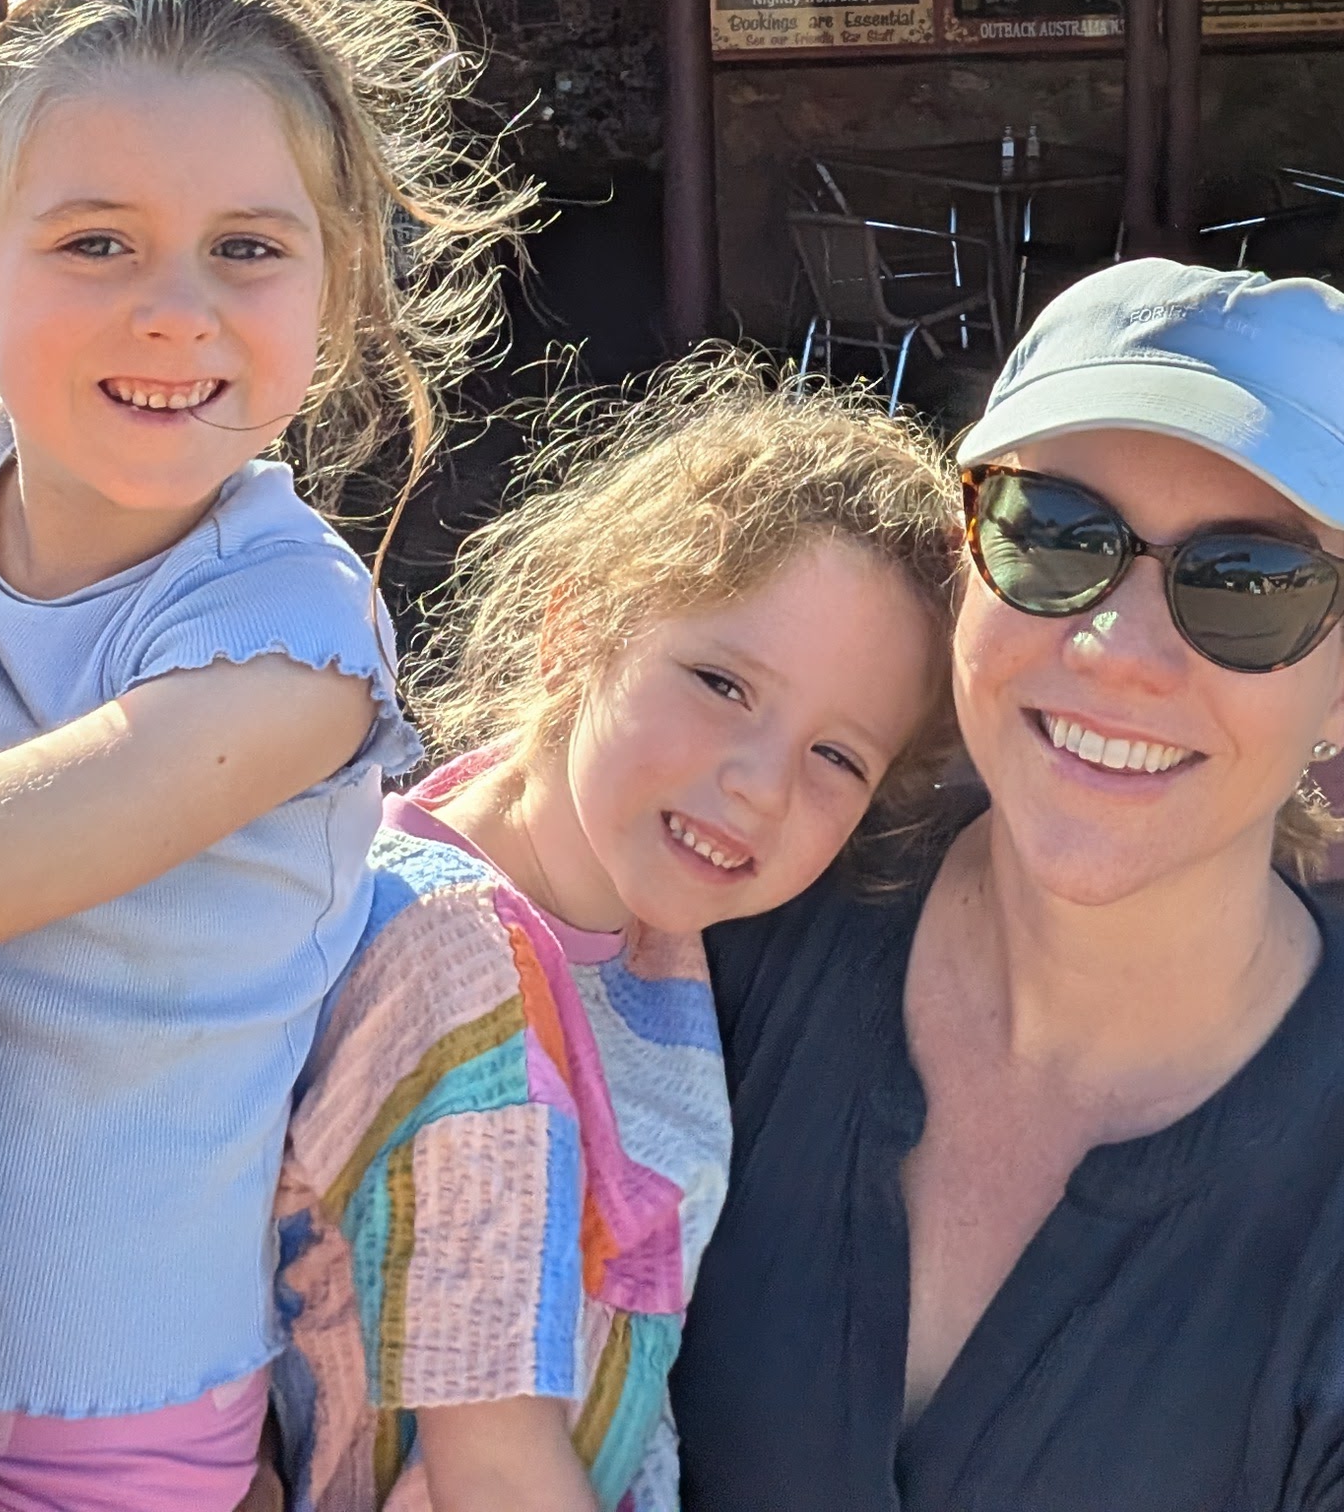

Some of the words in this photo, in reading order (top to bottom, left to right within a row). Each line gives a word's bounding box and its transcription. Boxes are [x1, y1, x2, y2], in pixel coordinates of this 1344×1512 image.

[728, 11, 798, 32] Bookings
[809, 15, 834, 29] are
[844, 8, 915, 28] Essential
[979, 22, 1037, 39] OUTBACK
[1038, 19, 1107, 37] AUSTRALIA
